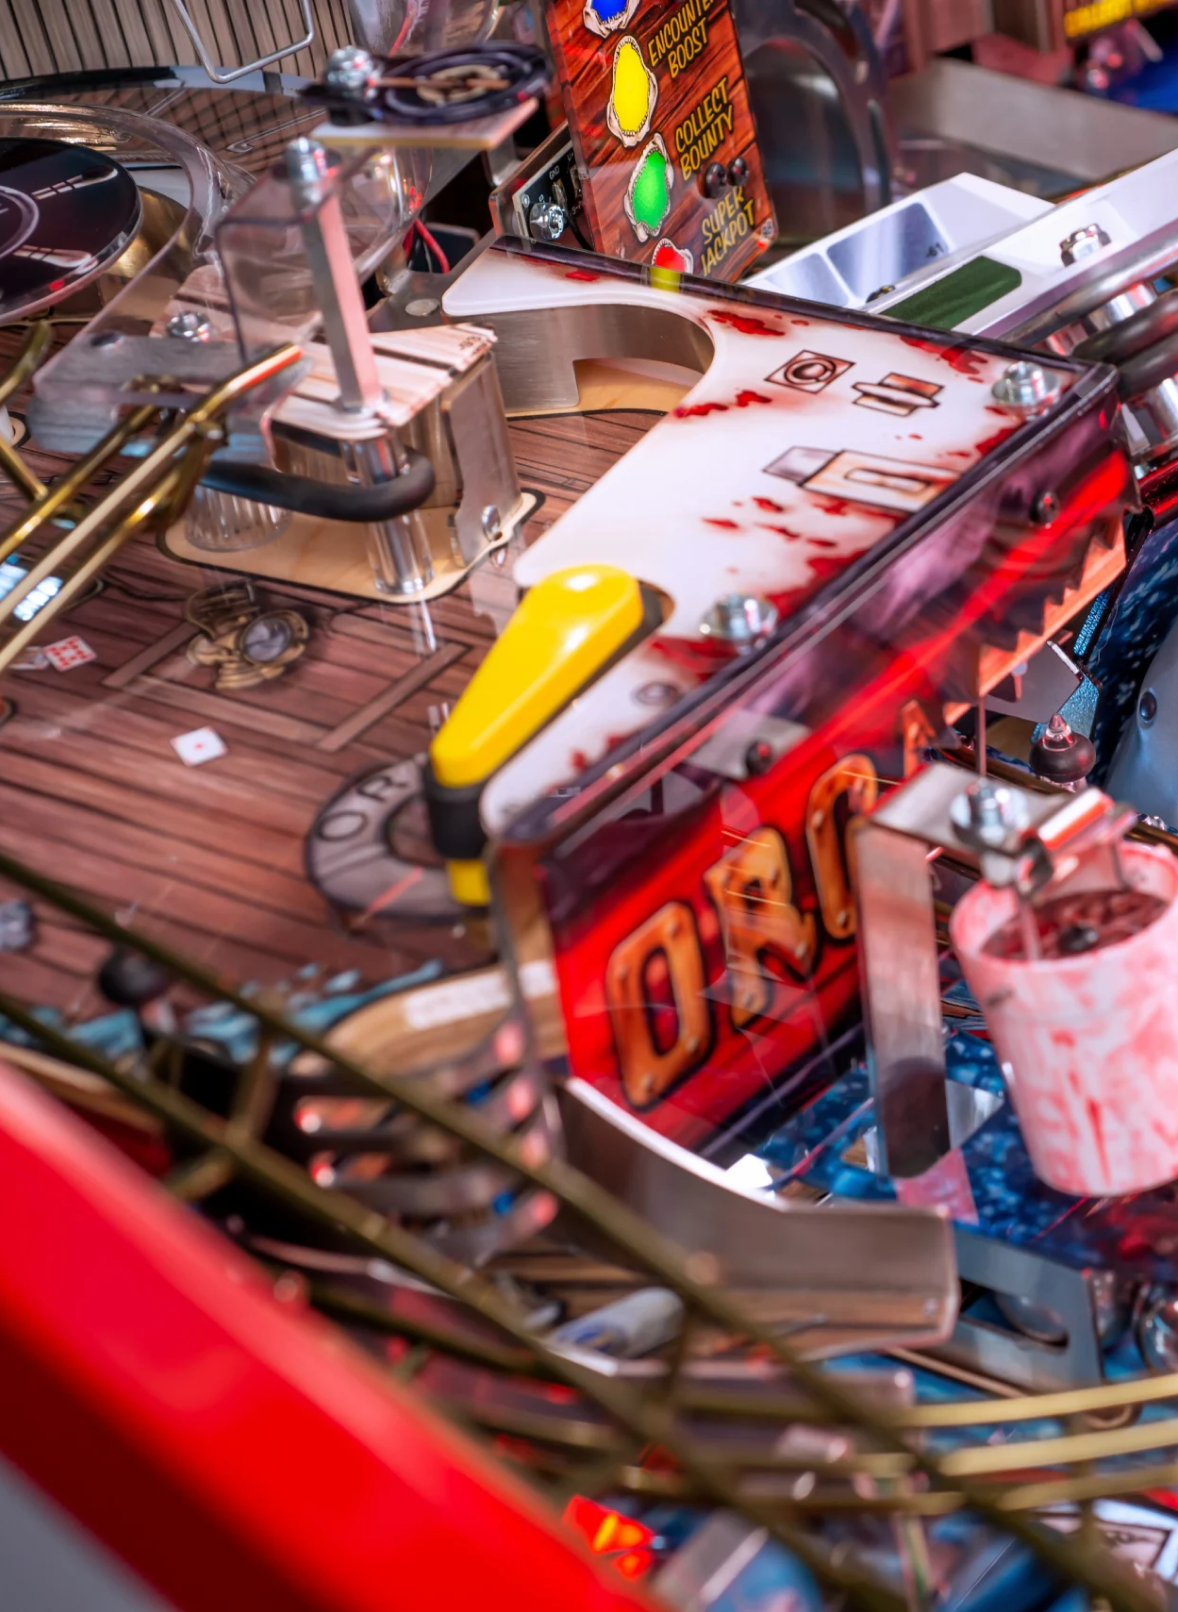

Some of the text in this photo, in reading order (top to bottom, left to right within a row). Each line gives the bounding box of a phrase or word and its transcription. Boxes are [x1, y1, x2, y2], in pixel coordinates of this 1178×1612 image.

[667, 16, 709, 78] BOOST
[675, 77, 729, 152] COLLECT
[679, 105, 735, 181] BOUNTY
[701, 186, 745, 244] SUPER
[701, 199, 755, 277] JACKPOT
